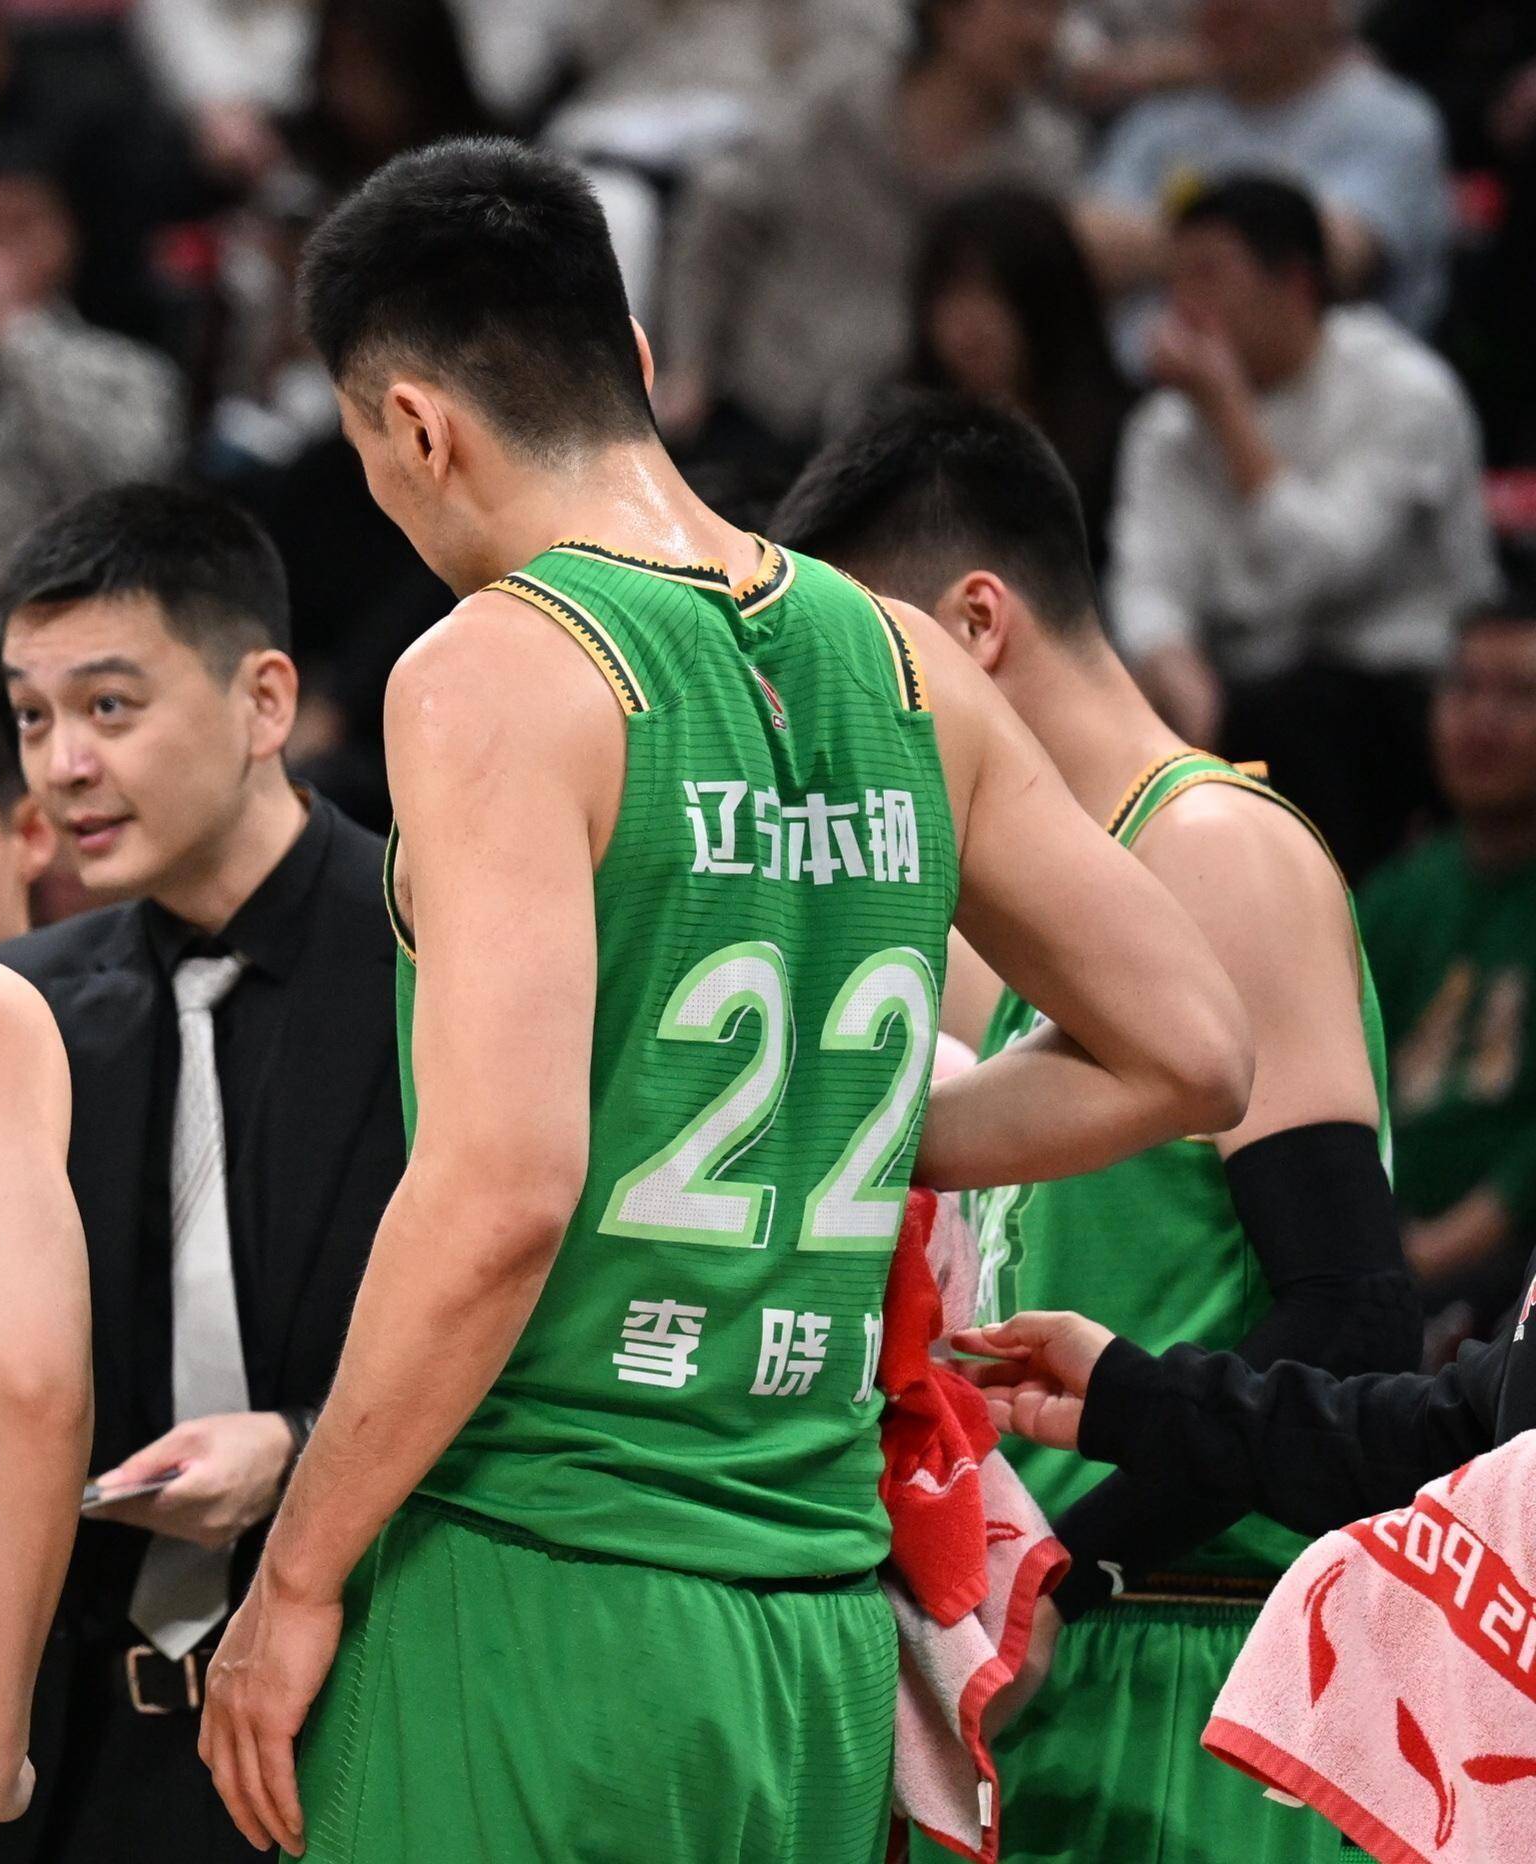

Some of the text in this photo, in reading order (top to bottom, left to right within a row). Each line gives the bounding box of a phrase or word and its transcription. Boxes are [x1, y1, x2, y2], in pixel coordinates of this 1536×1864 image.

[681, 779, 921, 885] 辽宁本钢
[597, 941, 940, 1251] 22
